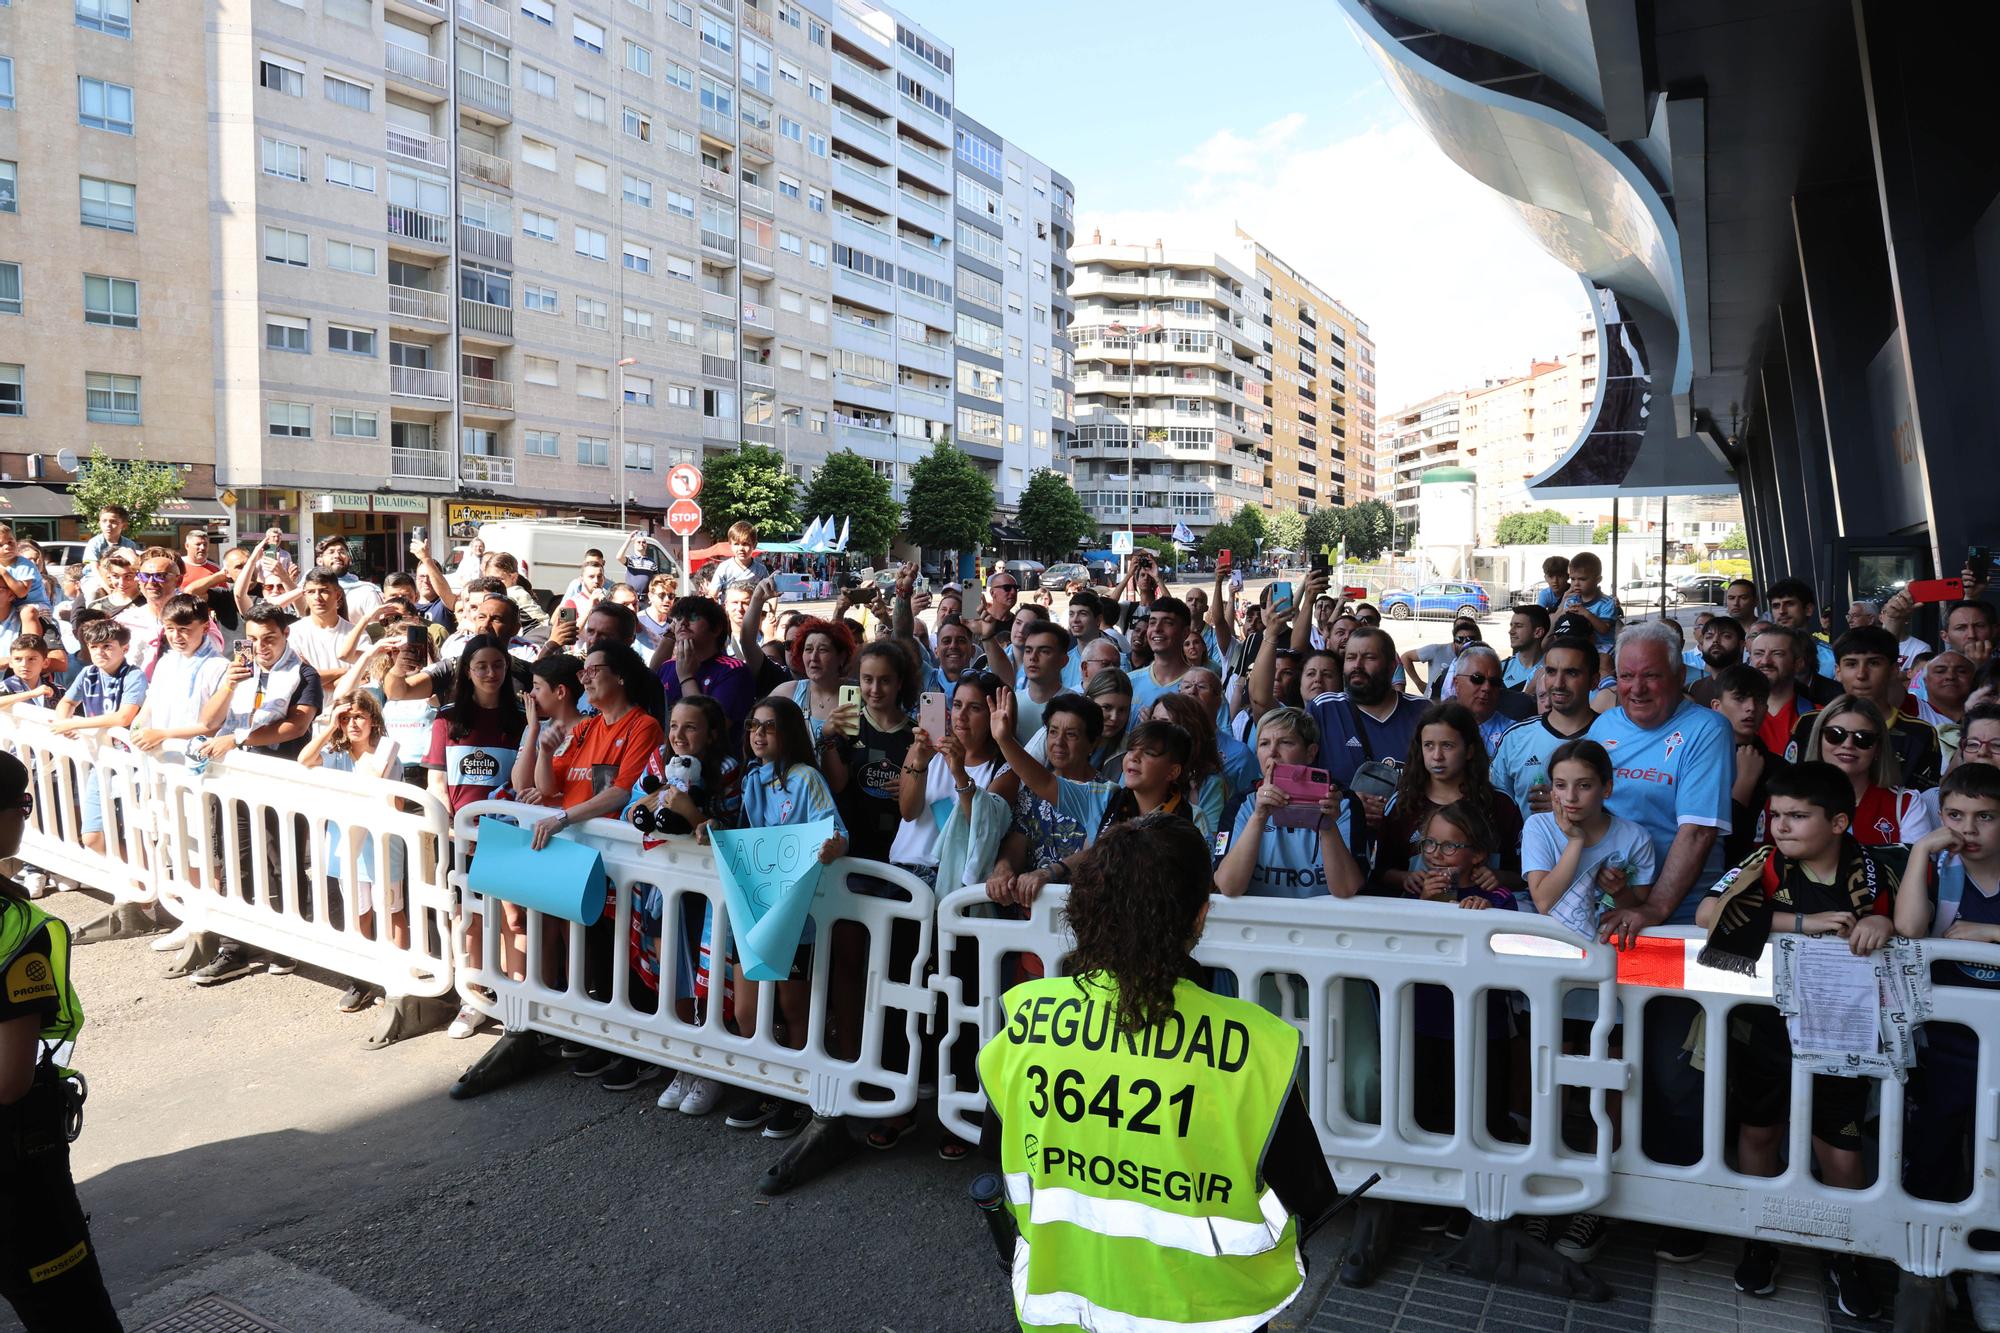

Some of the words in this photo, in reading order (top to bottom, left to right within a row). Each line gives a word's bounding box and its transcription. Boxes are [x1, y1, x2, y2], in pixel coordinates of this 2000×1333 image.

[332, 495, 369, 506] TALERIA
[374, 496, 417, 508] BALAIDOS
[671, 513, 698, 522] STOP
[463, 757, 495, 768] Estrella
[464, 765, 494, 775] Galicia
[866, 767, 900, 780] Estrella
[866, 776, 886, 788] Gali
[1251, 863, 1328, 888] CITROË
[1007, 997, 1250, 1073] SEGURIDAD
[1026, 1065, 1196, 1138] 36421
[36, 1248, 84, 1278] PROSEGUR
